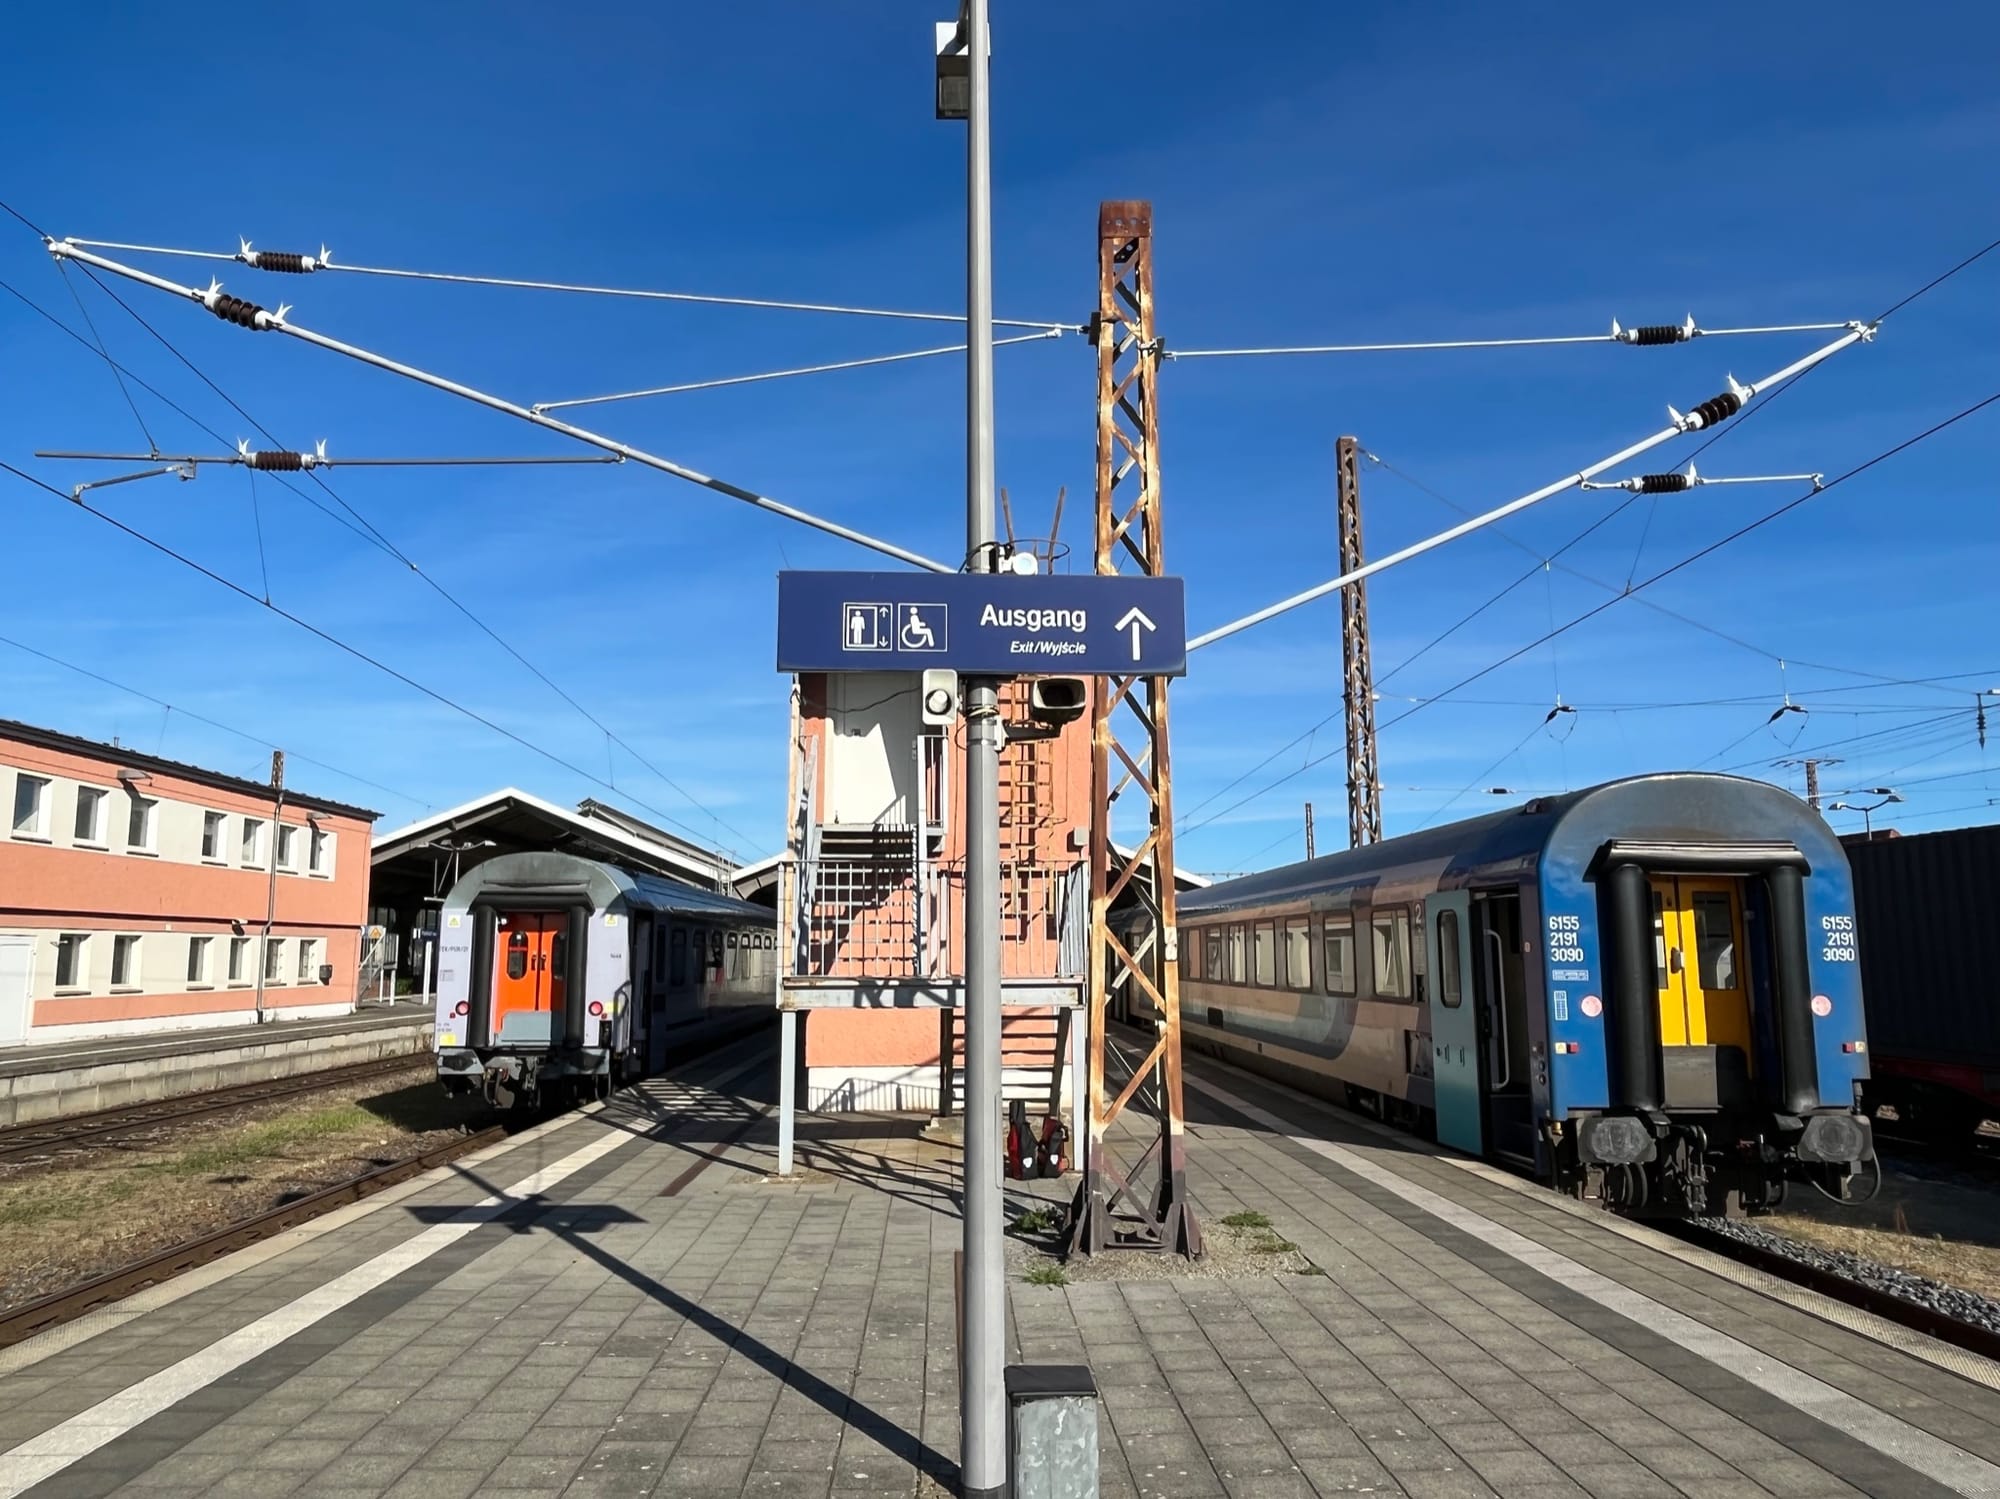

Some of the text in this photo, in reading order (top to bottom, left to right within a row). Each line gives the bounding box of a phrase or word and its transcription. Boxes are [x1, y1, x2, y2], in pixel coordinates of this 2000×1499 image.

[980, 604, 1086, 632] Ausgang
[1415, 904, 1422, 924] 2
[1549, 916, 1580, 930] 6155
[1822, 916, 1852, 930] 6155
[1550, 932, 1577, 946] 2191
[1827, 932, 1854, 946] 2191
[1551, 948, 1584, 962] 3090
[1823, 948, 1855, 962] 3090
